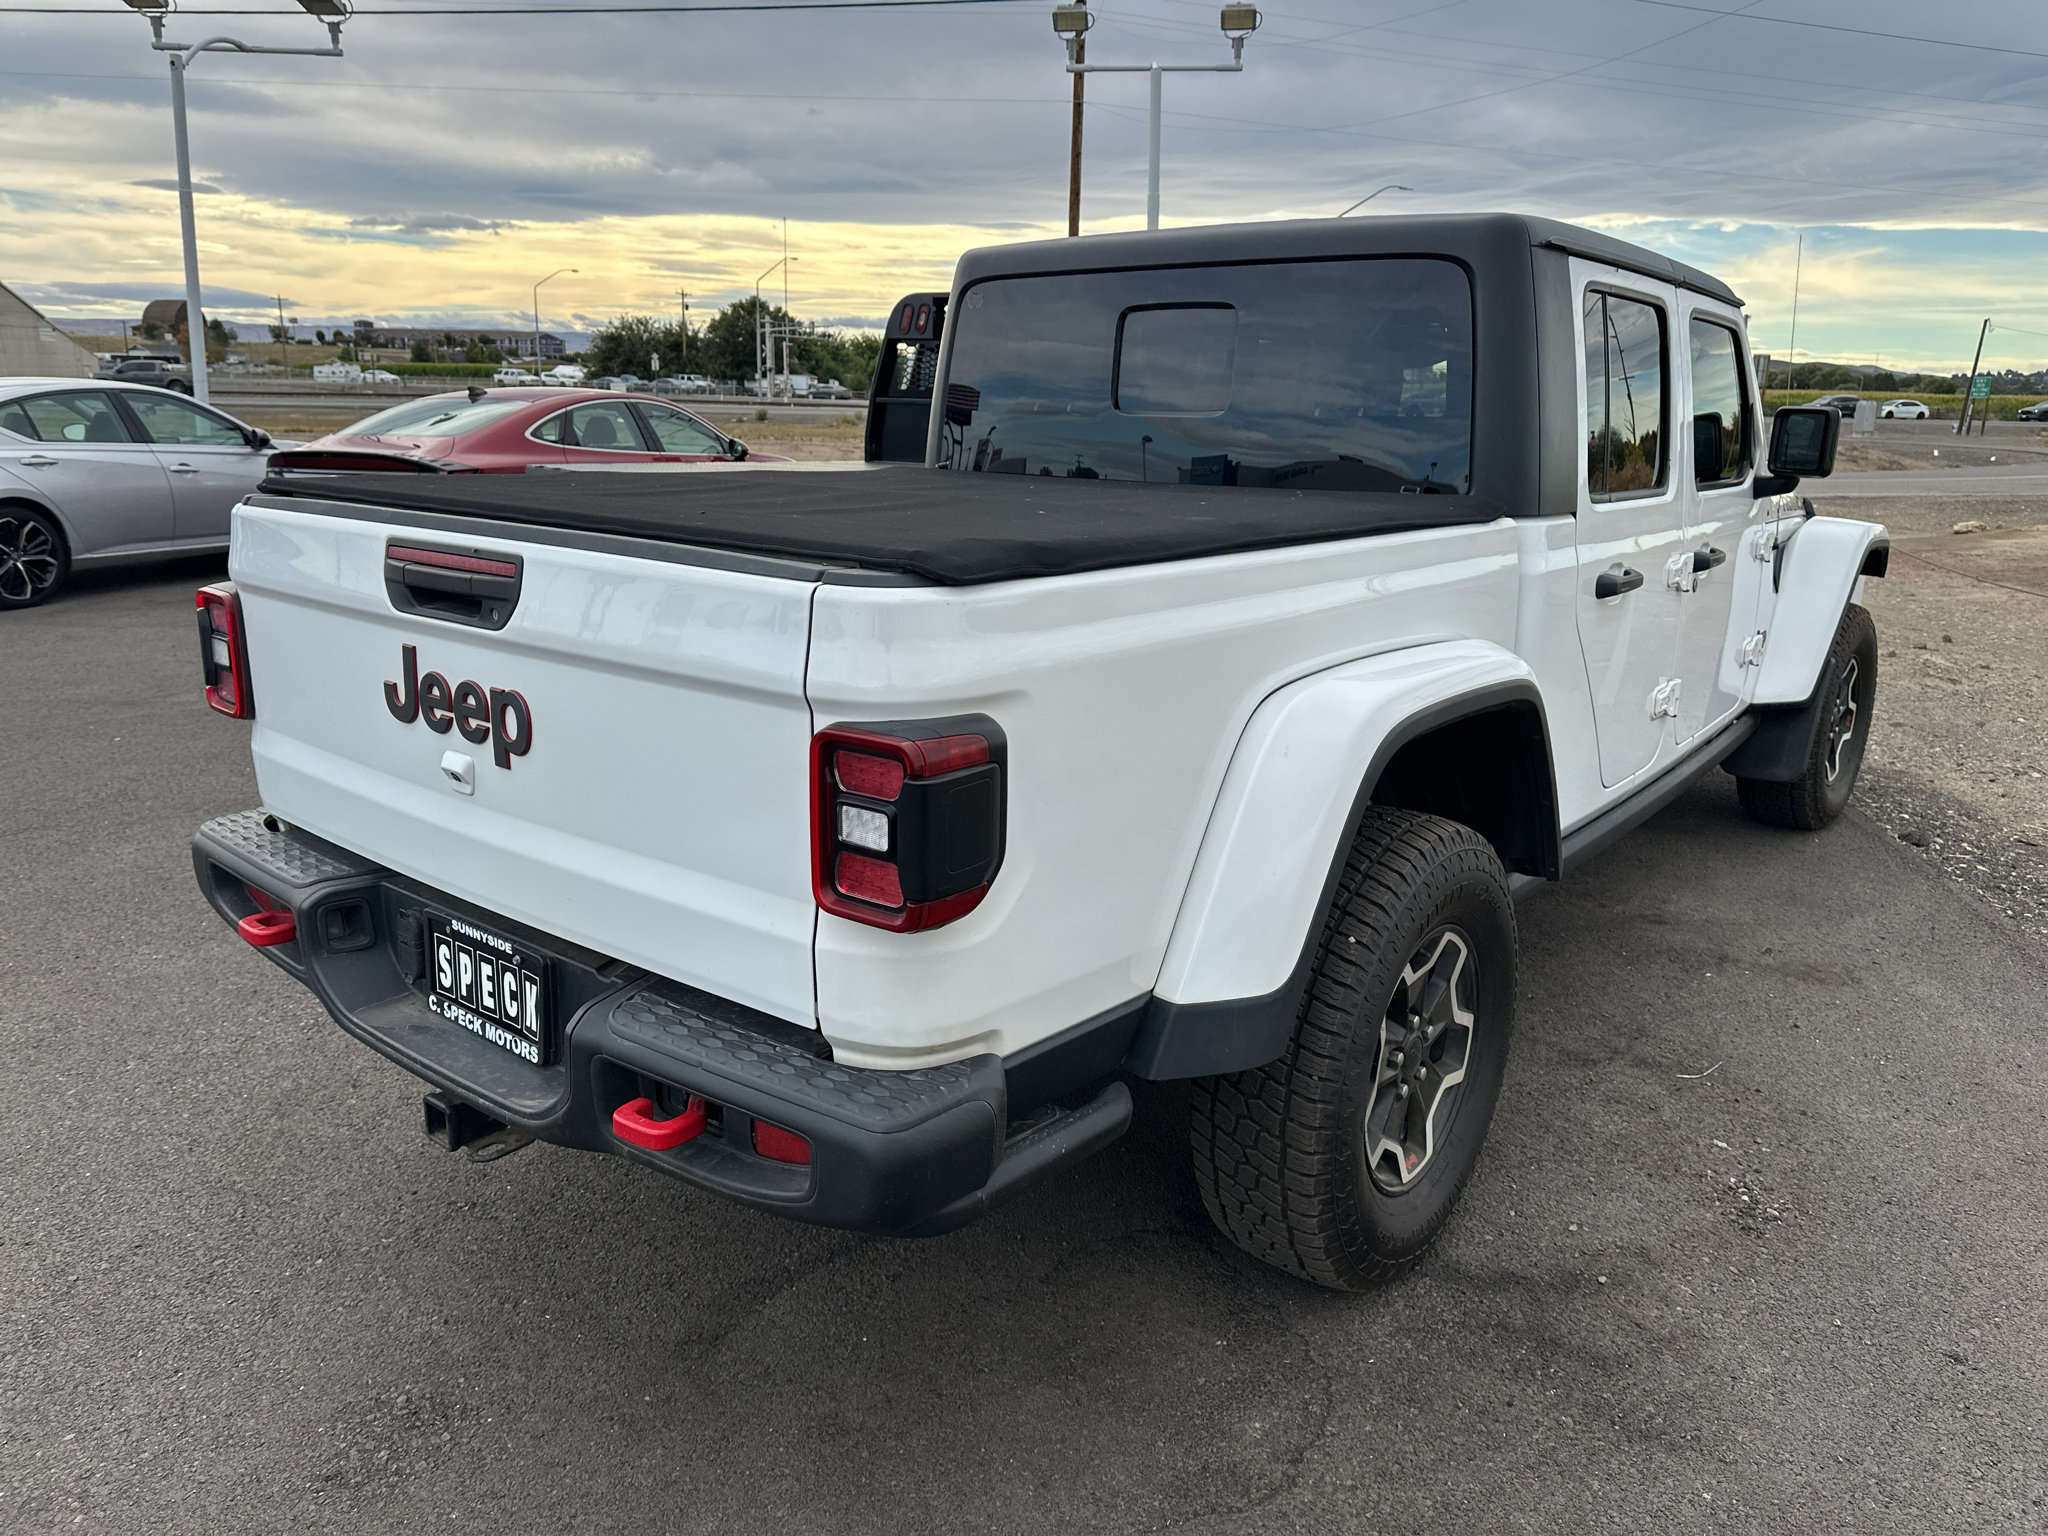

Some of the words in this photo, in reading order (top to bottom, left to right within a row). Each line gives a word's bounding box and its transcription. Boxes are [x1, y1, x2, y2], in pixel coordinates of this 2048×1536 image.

[383, 643, 533, 770] Jeep
[451, 919, 513, 955] SUNNYSIDE
[438, 943, 538, 1033] SPECK
[428, 994, 441, 1014] C.
[443, 1001, 483, 1036] SPECK
[485, 1022, 539, 1064] MOTORS
